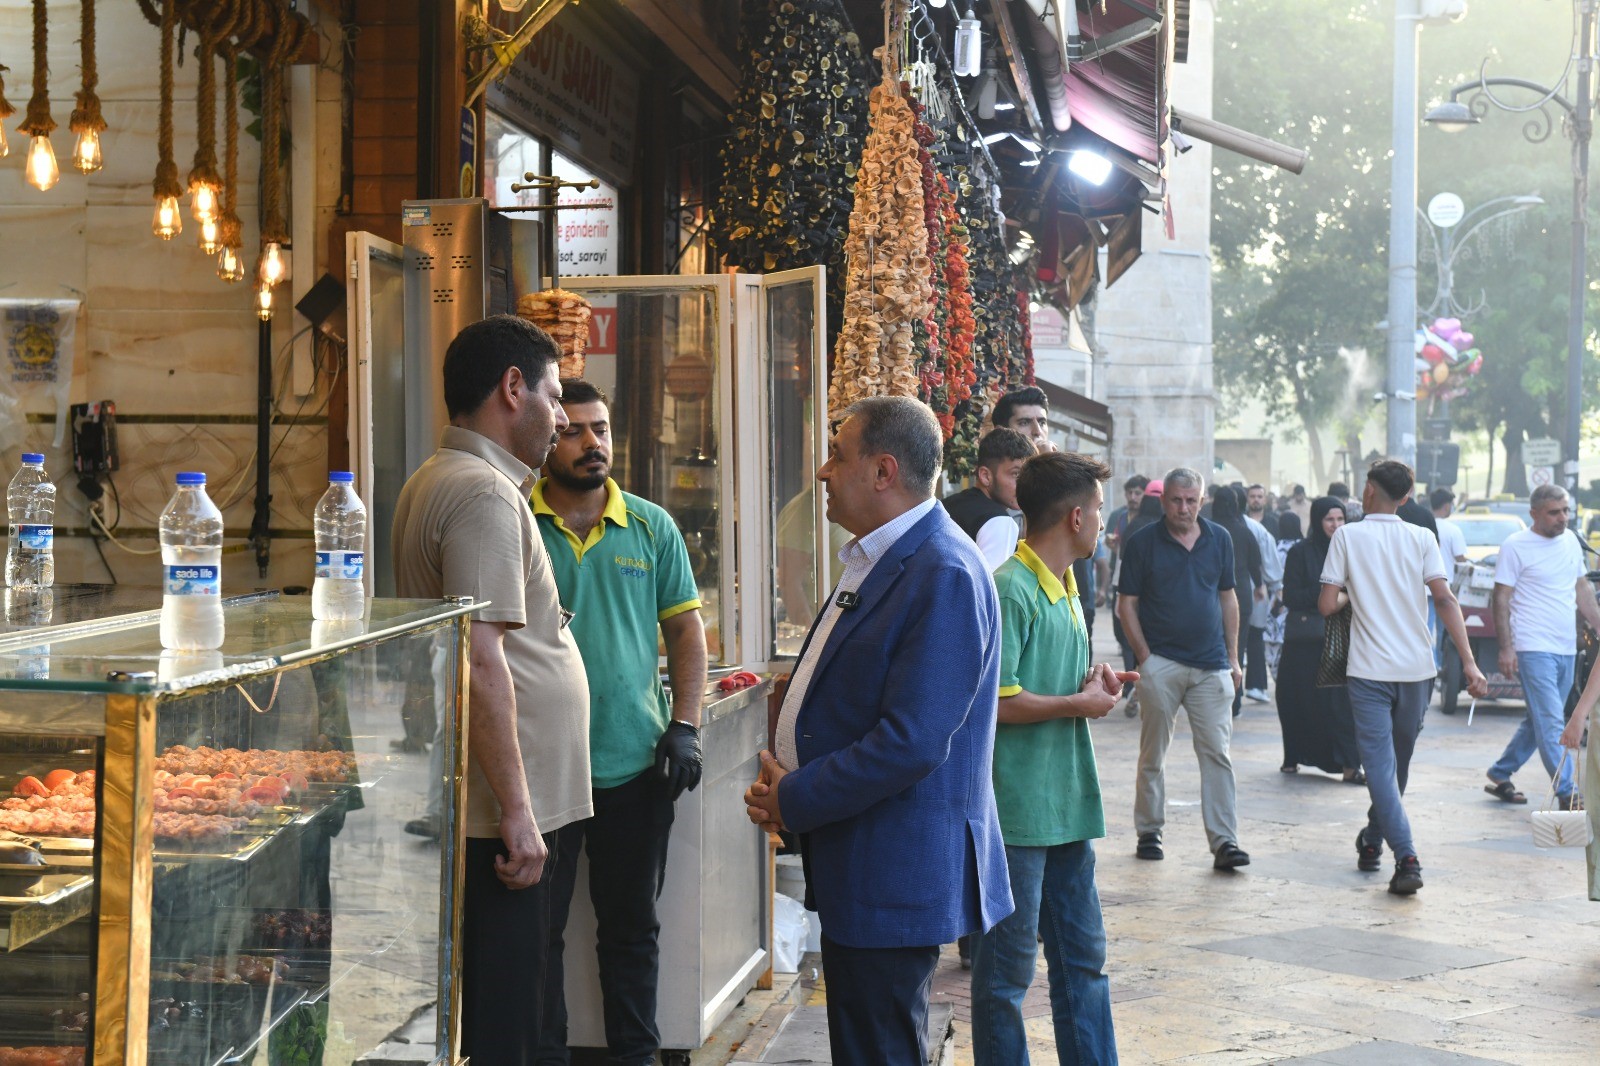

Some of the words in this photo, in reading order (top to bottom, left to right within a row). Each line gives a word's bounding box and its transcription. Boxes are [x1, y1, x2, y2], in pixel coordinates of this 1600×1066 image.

[565, 220, 609, 242] gönderilir
[557, 248, 608, 266] sot_sarayi
[175, 568, 199, 579] sade
[200, 568, 213, 578] life
[620, 567, 646, 579] GROUP
